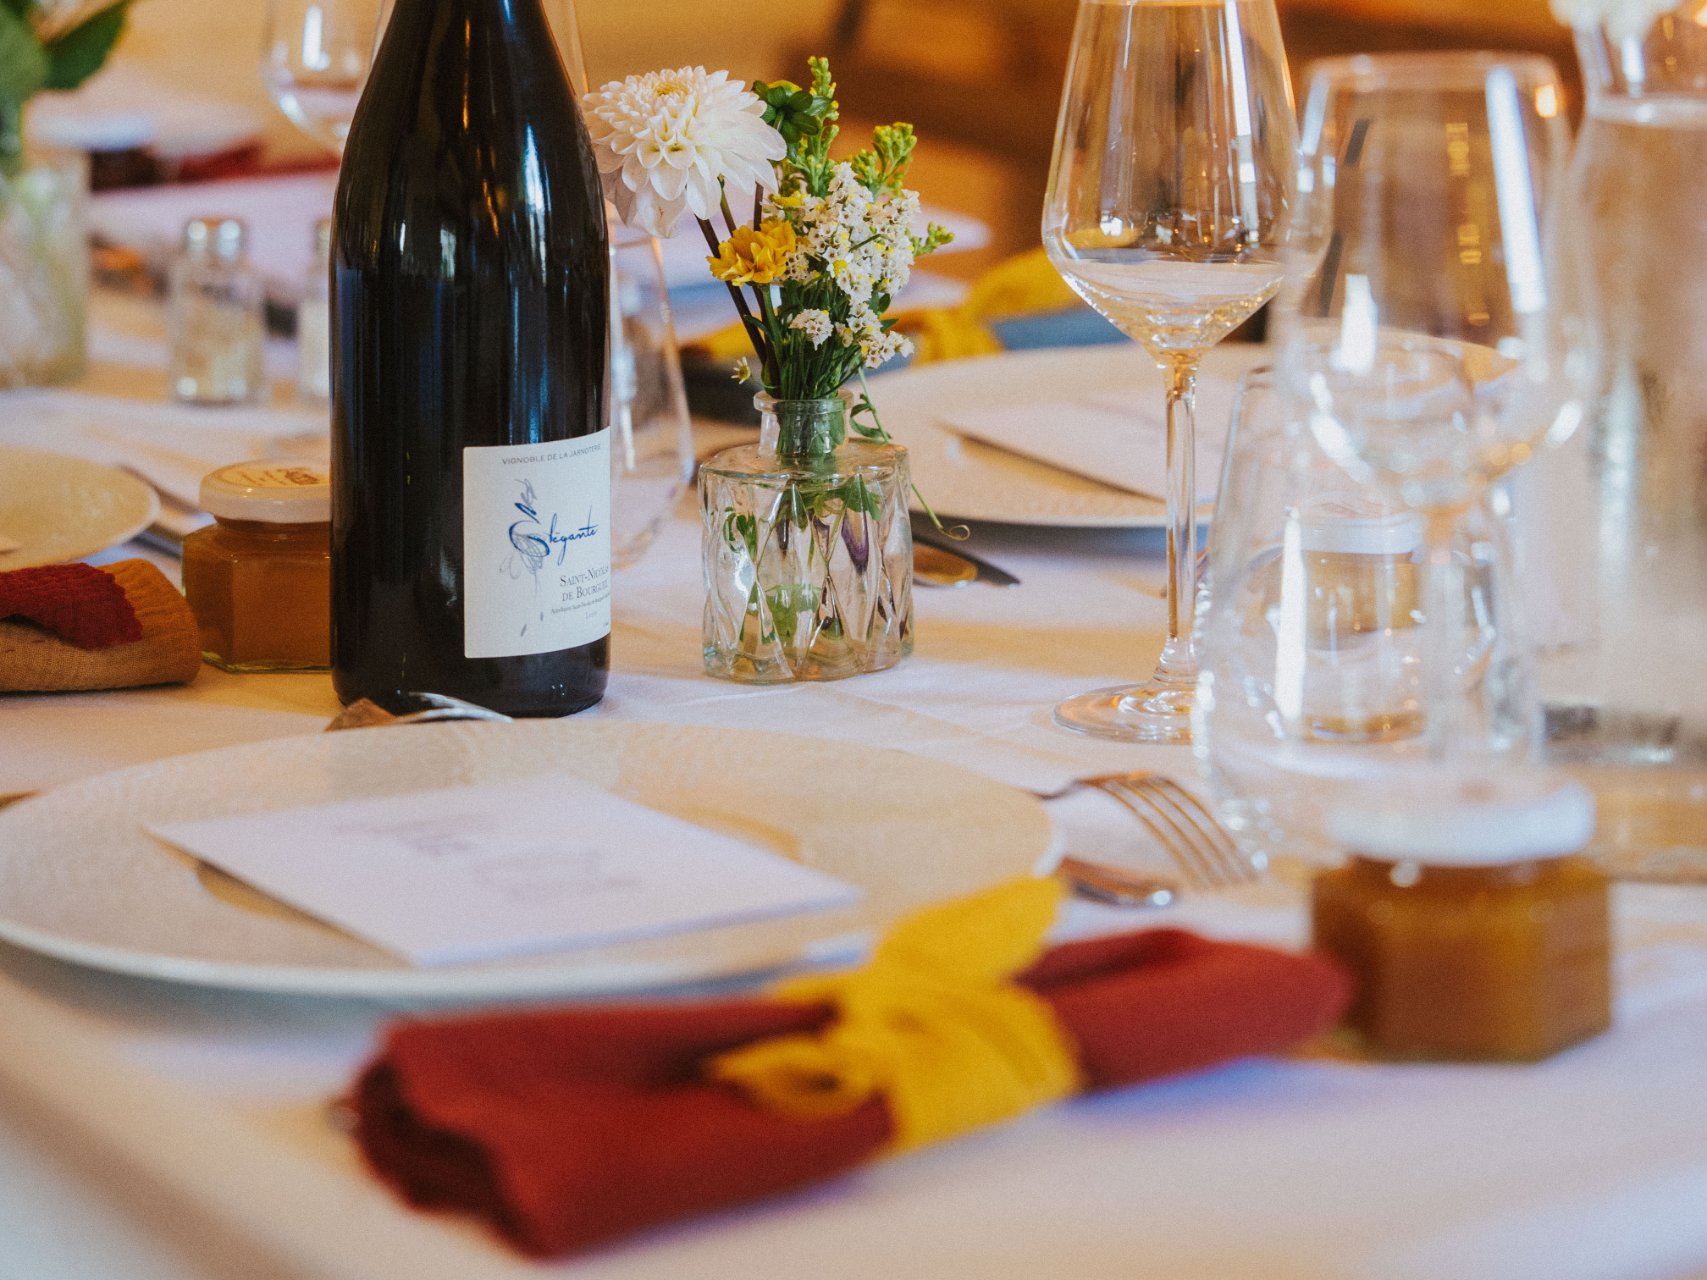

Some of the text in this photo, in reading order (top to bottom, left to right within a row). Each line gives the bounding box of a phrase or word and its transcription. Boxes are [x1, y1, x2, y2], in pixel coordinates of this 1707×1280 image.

[502, 454, 545, 465] VIGNOBLE
[547, 452, 559, 461] DE
[560, 450, 570, 459] LA
[562, 591, 574, 602] DE
